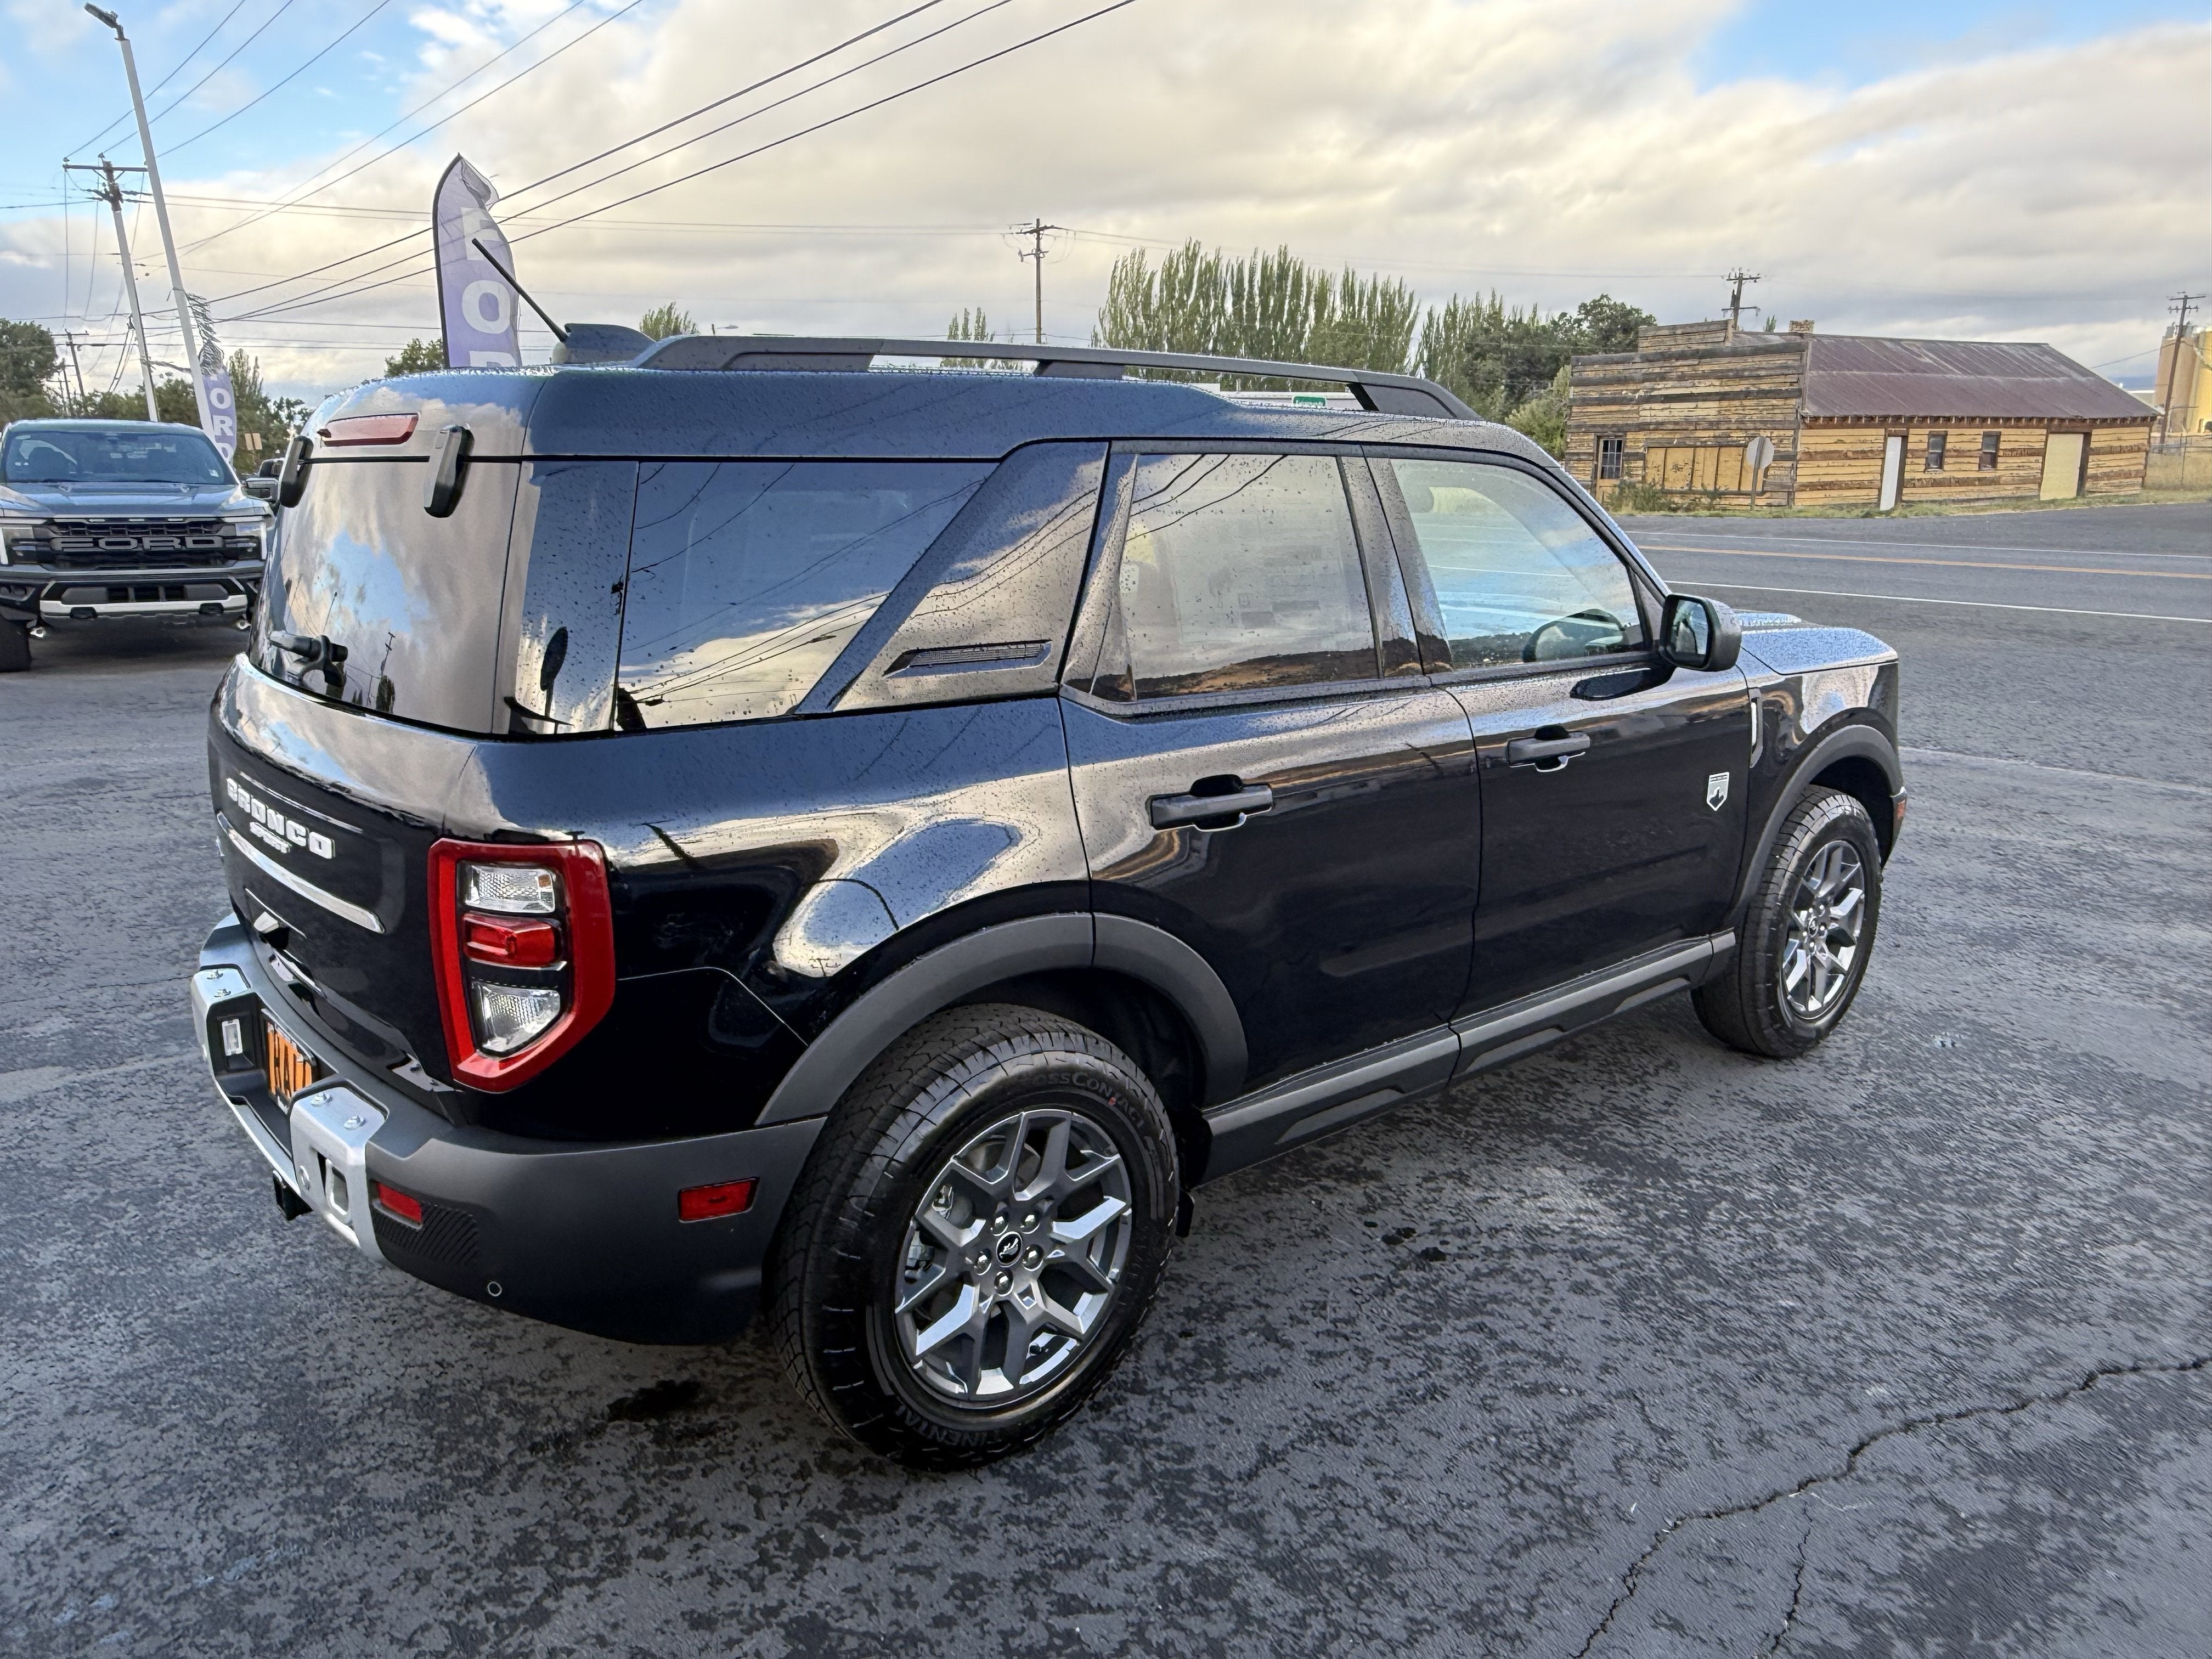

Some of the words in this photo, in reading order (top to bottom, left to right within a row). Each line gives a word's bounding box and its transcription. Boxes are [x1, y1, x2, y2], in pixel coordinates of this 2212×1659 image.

[210, 369, 234, 462] ORD
[49, 536, 223, 552] FORD
[227, 777, 336, 859] BRONCO
